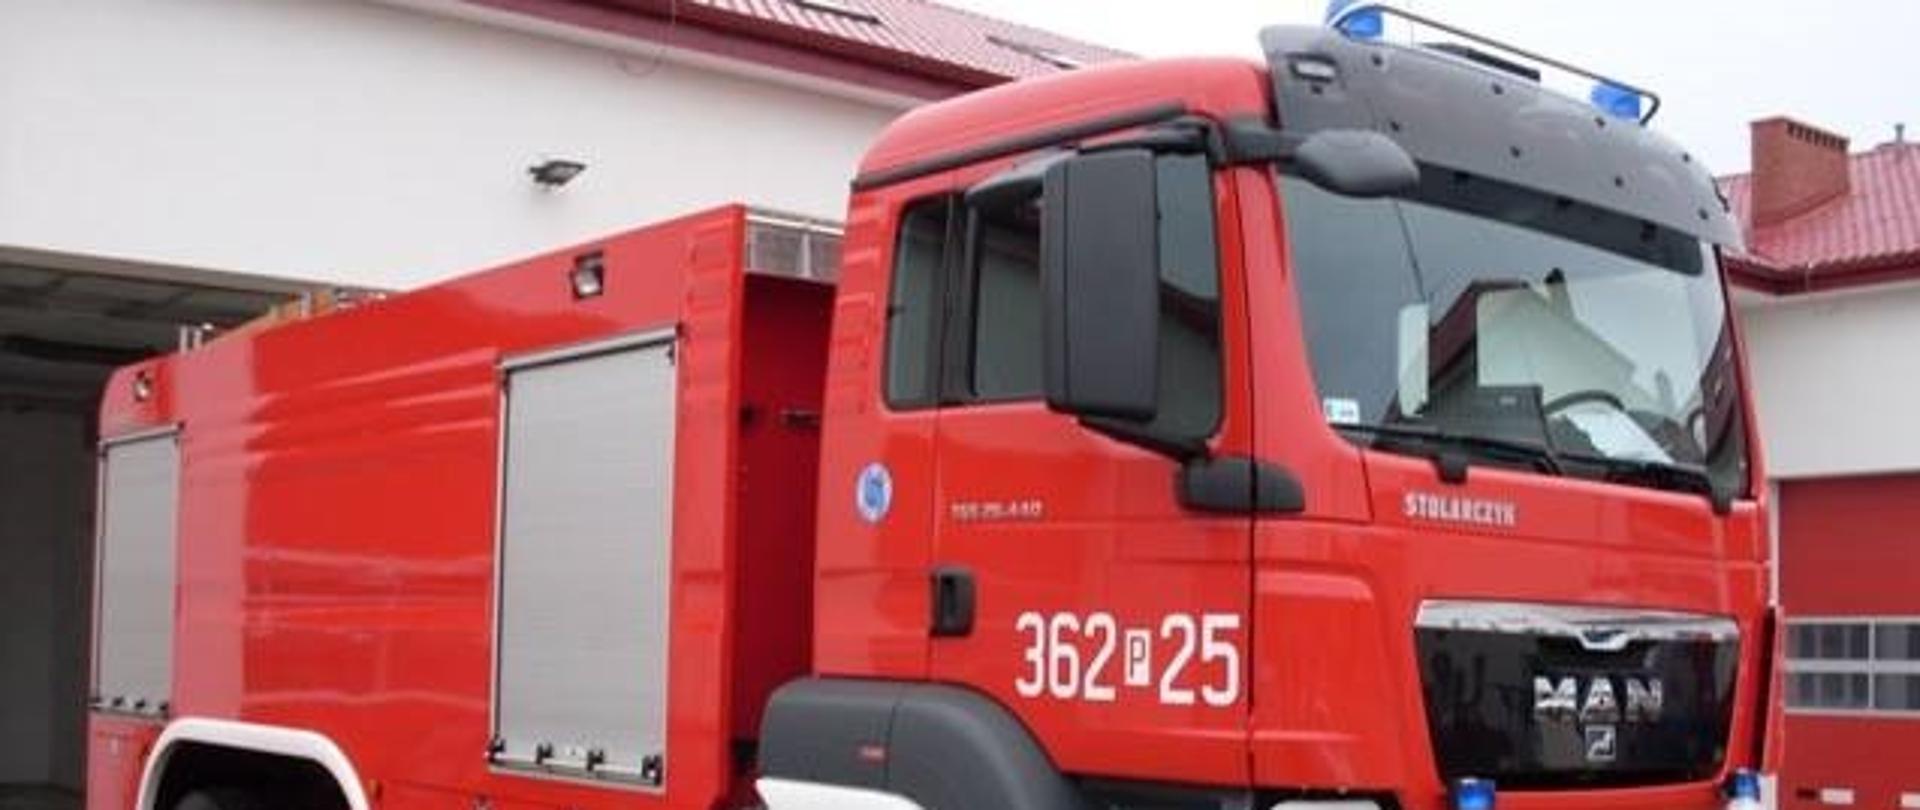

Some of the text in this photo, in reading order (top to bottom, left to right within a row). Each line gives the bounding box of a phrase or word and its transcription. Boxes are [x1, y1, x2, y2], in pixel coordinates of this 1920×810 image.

[1404, 493, 1515, 526] STOLARCZYK
[1015, 611, 1240, 706] 362 P 25
[1533, 676, 1662, 722] MAN
